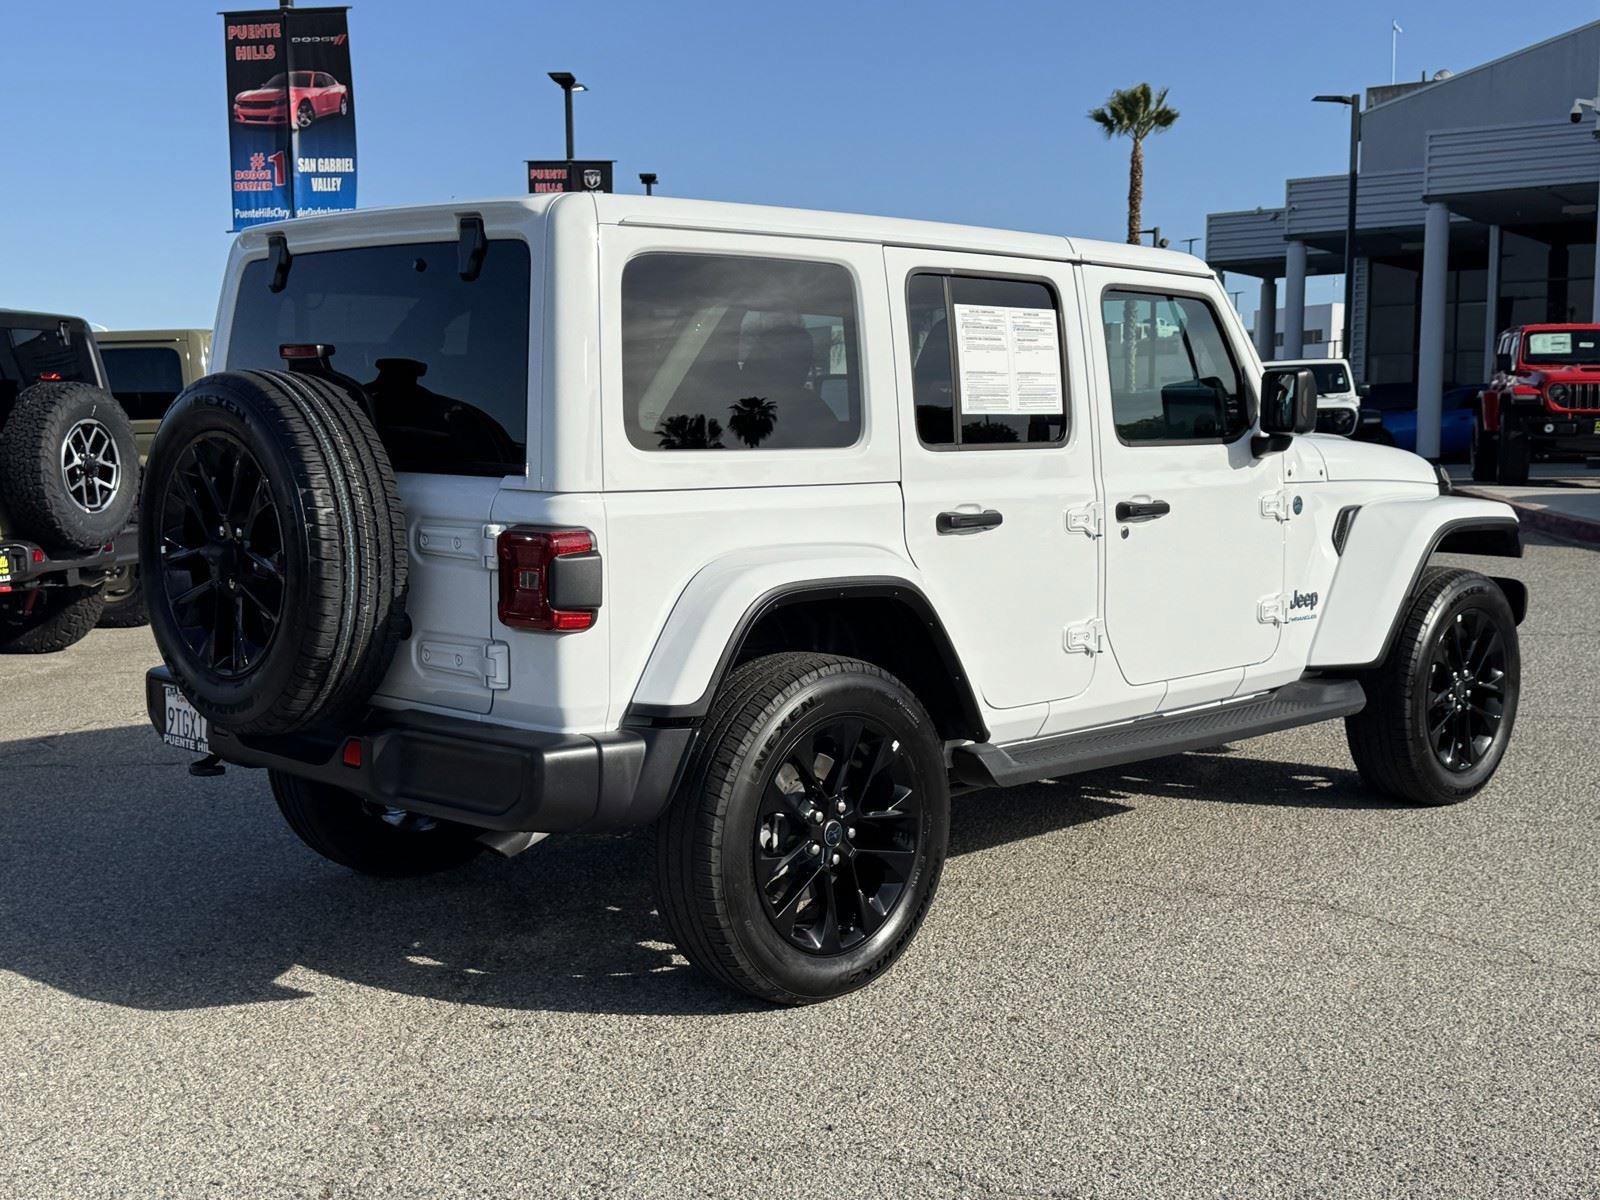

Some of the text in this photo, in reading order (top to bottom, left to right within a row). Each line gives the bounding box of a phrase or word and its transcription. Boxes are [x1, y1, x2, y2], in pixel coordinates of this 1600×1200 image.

[227, 23, 281, 40] PUENTE
[235, 44, 276, 60] HILLS
[298, 158, 354, 172] SAN GABRIEL
[234, 170, 271, 180] DODGE
[234, 181, 272, 191] DEALER
[311, 177, 342, 192] VALLEY
[1290, 590, 1318, 610] Jeep
[754, 696, 815, 770] NEXEN
[163, 734, 195, 750] PUENTE
